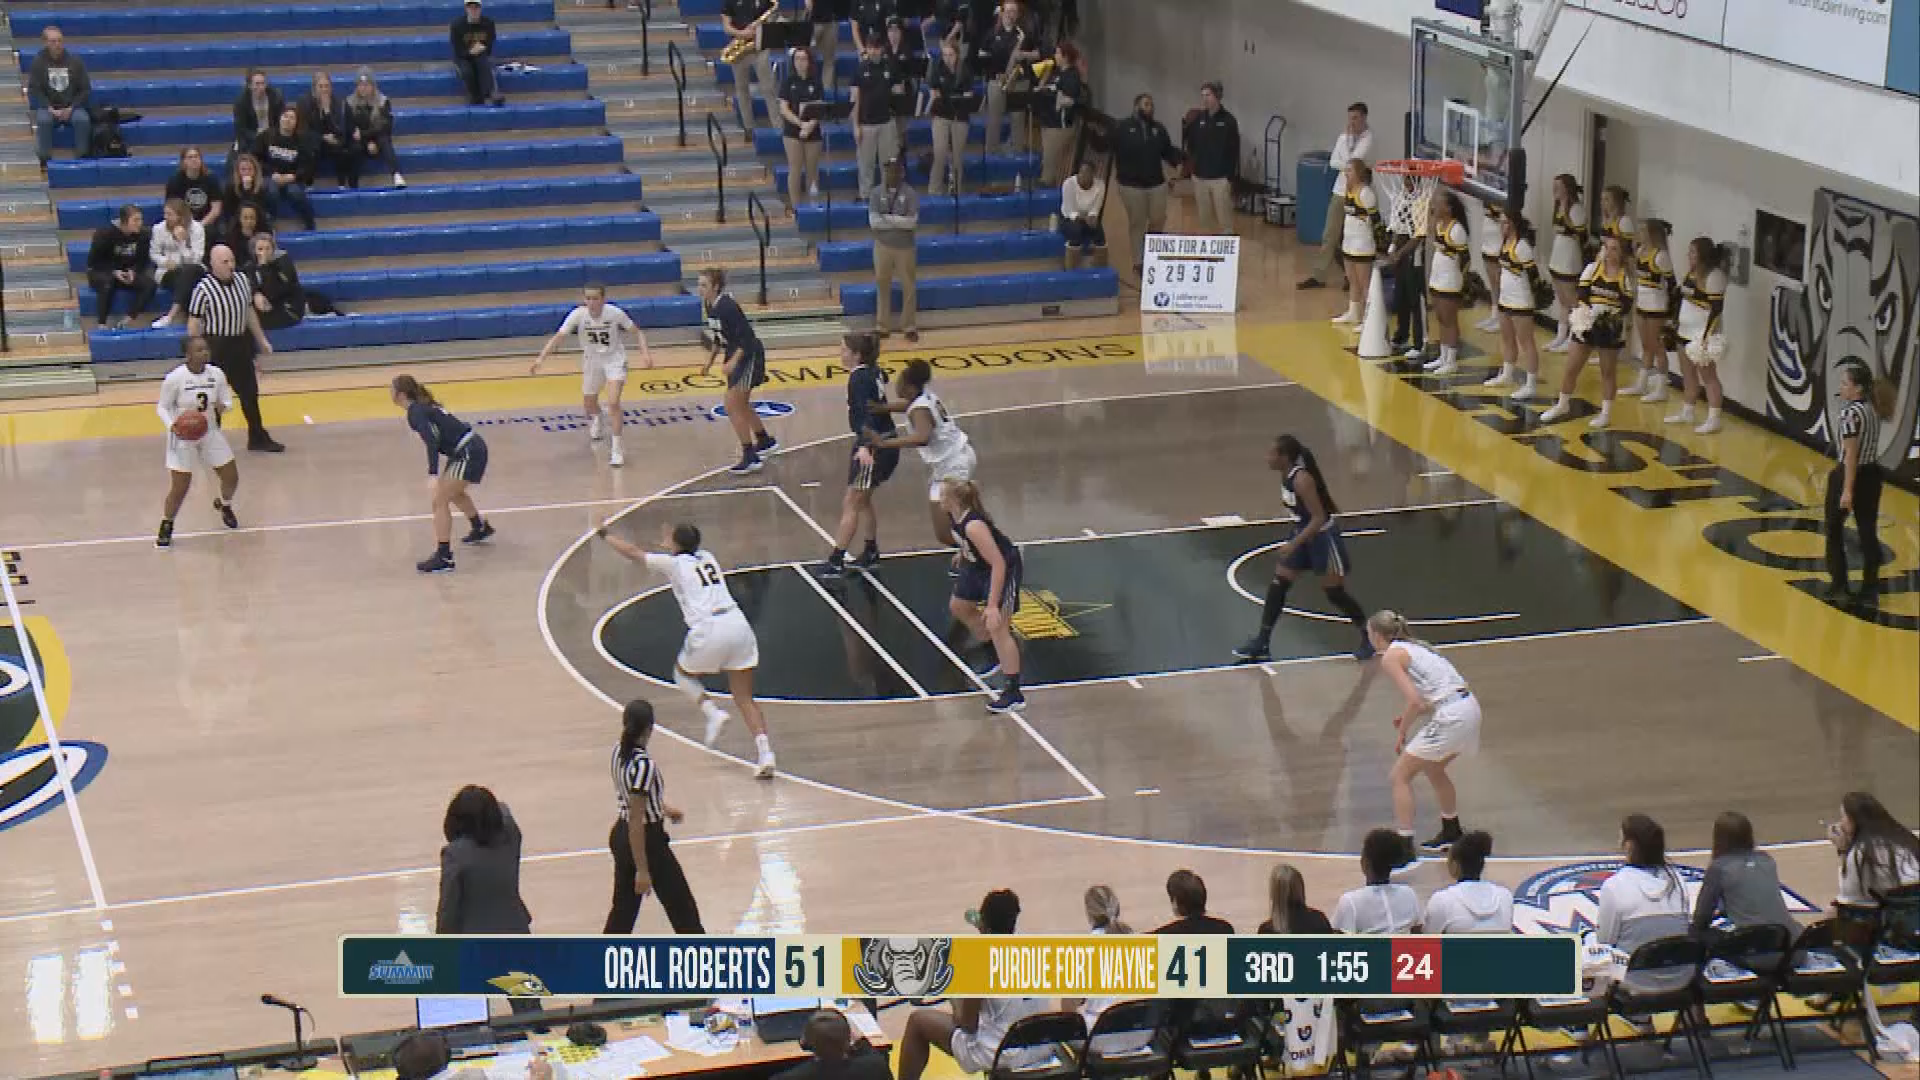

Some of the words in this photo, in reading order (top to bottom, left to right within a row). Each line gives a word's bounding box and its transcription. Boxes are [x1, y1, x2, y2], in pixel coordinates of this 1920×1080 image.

[1148, 237, 1176, 253] DONS
[1178, 239, 1198, 253] FOR
[1200, 239, 1208, 253] A
[1210, 239, 1236, 255] CURE
[1147, 265, 1156, 286] $
[195, 391, 209, 412] 3
[695, 563, 721, 587] 12
